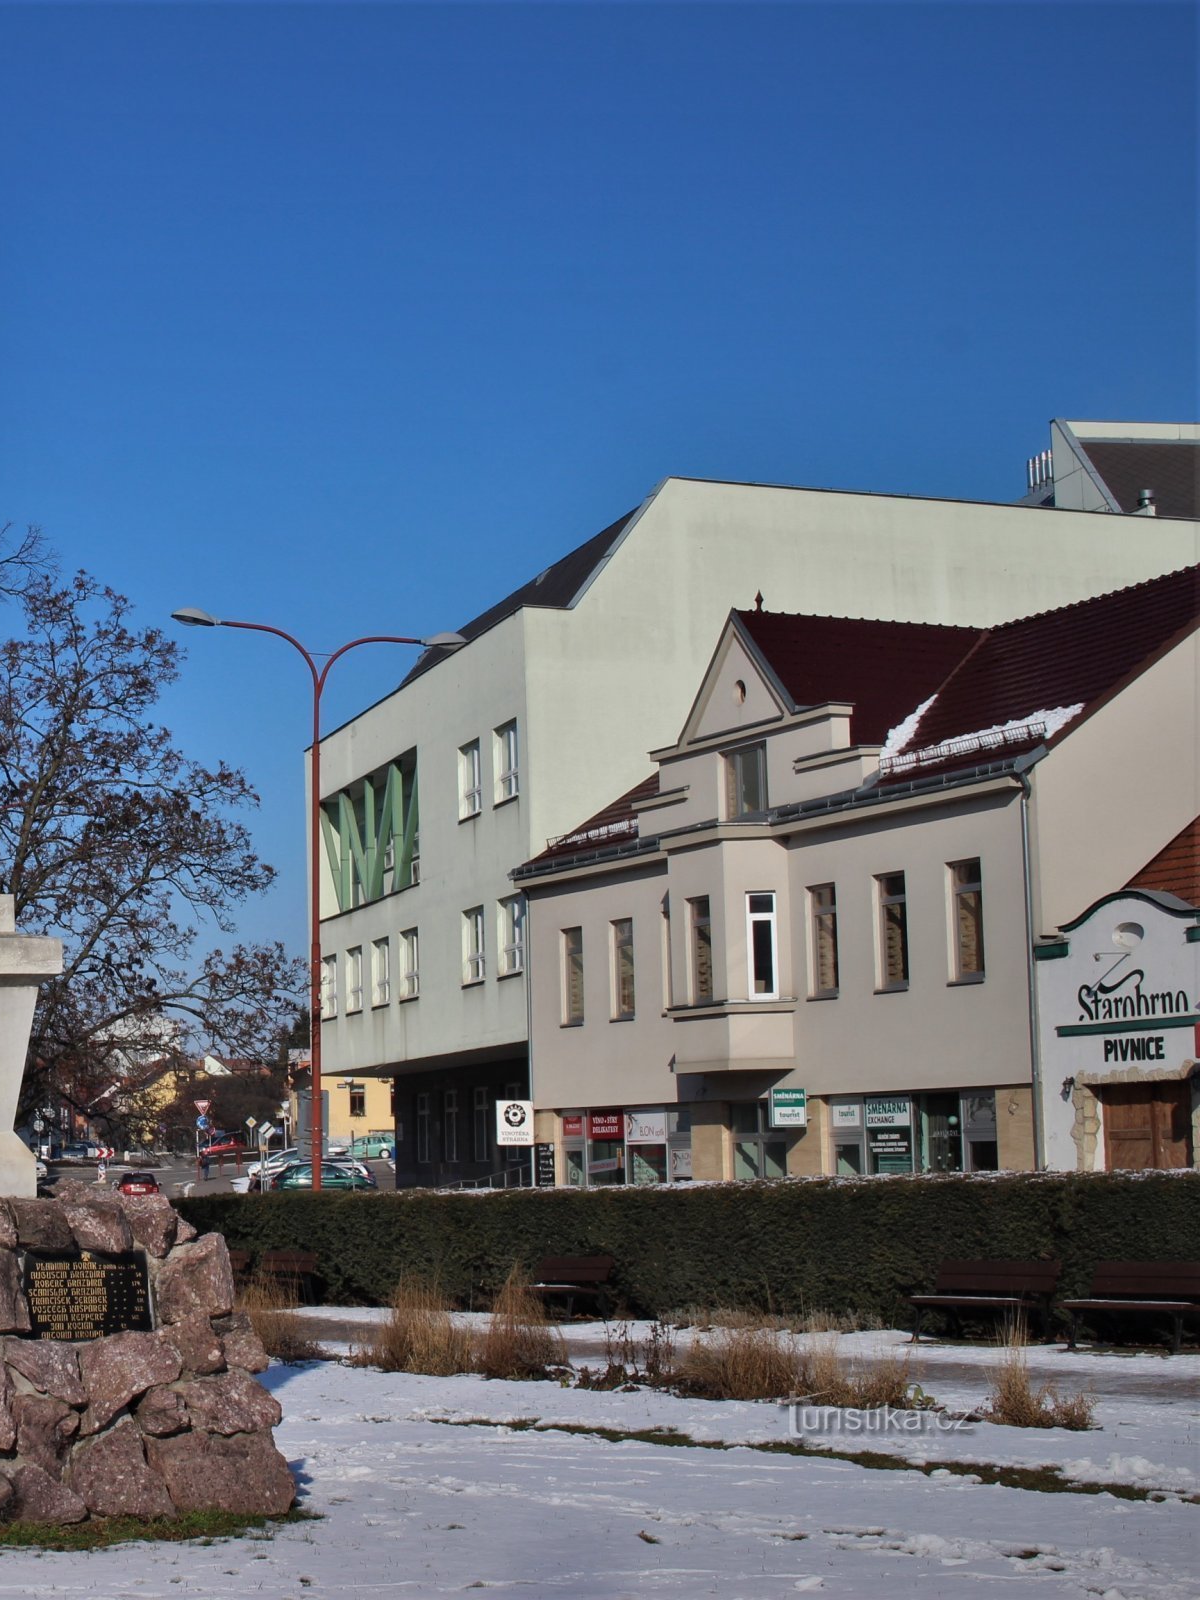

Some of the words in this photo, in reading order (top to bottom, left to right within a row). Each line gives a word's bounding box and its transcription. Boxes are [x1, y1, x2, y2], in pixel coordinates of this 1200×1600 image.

[1078, 969, 1189, 1021] Starobrno
[1103, 1036, 1165, 1062] PIVNICE
[773, 1091, 804, 1099] SMĚNÁRNA
[867, 1100, 907, 1114] SMĚNÁRNA
[779, 1110, 800, 1118] tourist
[838, 1109, 856, 1117] tourist
[868, 1116, 895, 1124] EXCHANGE
